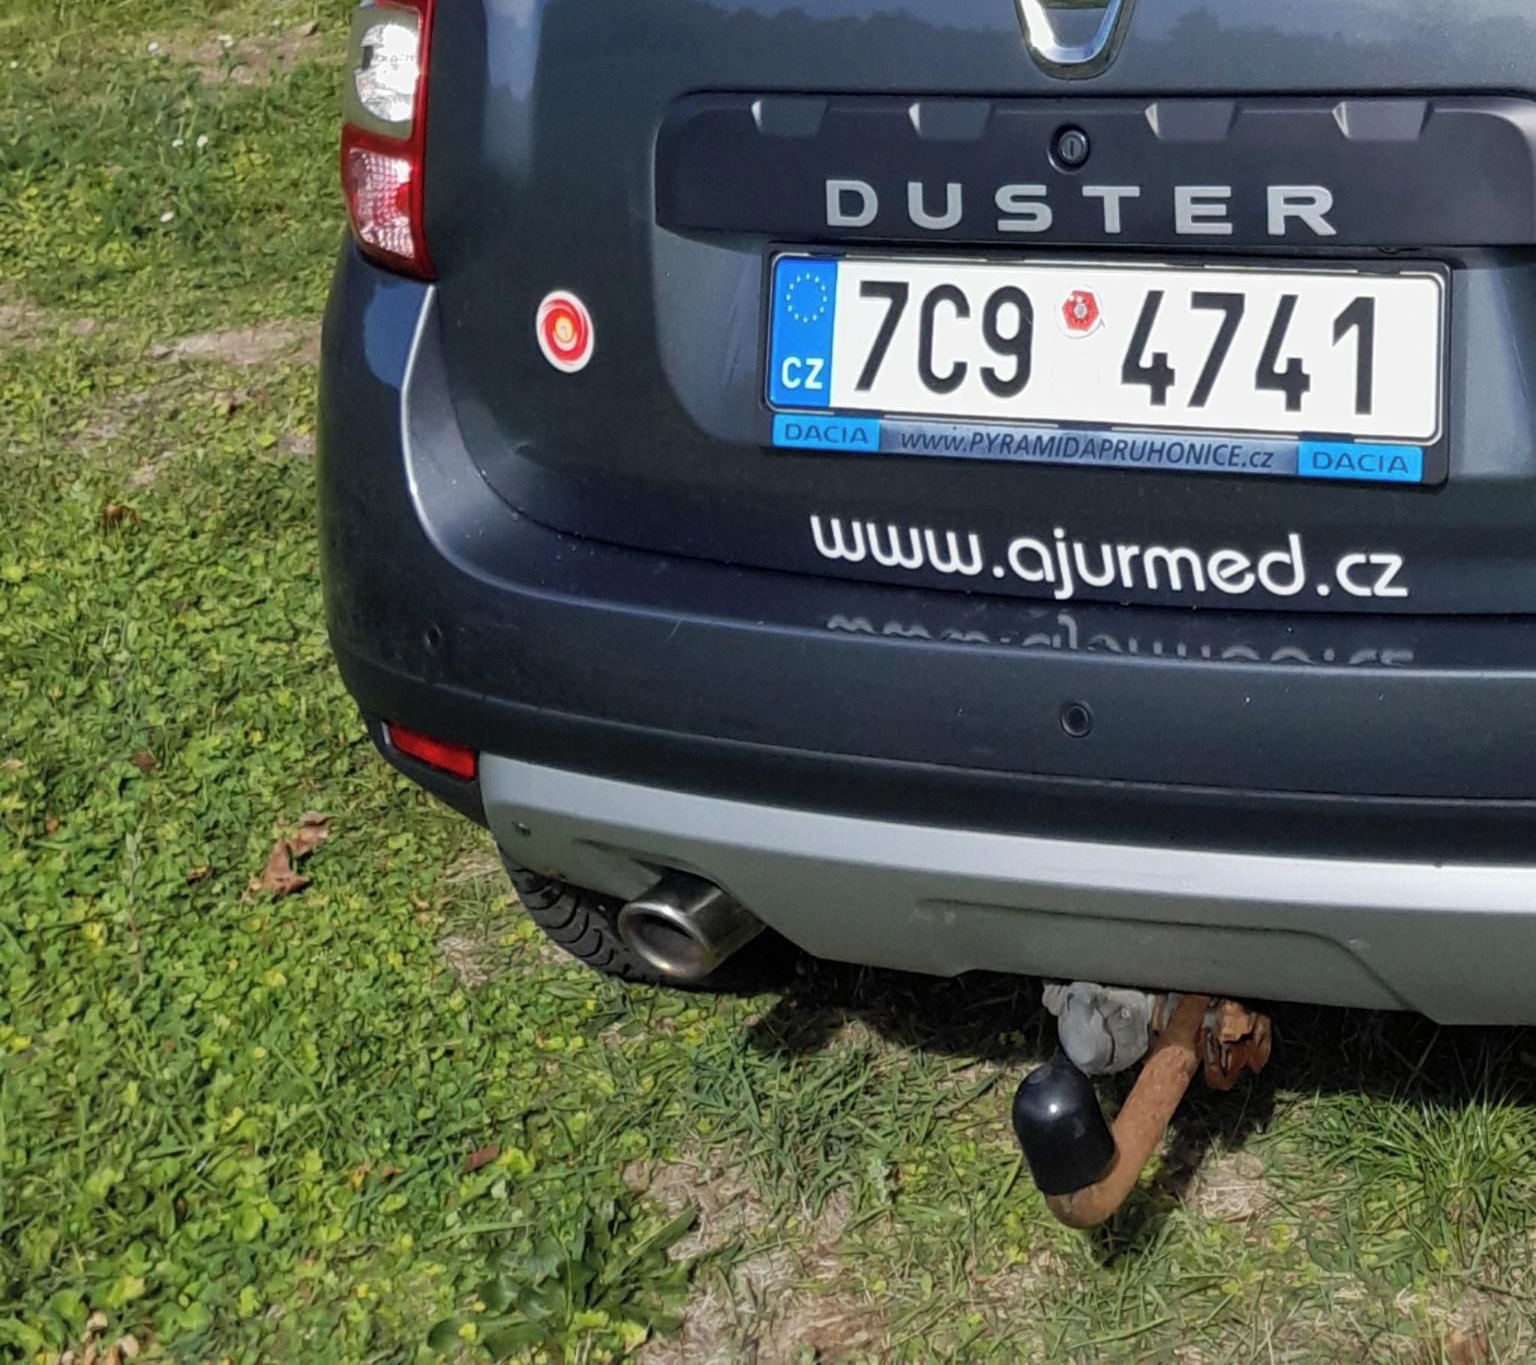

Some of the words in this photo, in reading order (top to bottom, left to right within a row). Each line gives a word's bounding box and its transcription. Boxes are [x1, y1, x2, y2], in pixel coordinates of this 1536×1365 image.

[825, 179, 1336, 237] DUSTER
[854, 280, 1034, 398] 7C9
[1121, 290, 1375, 415] 4741
[781, 356, 824, 390] CZ
[784, 423, 868, 444] DACIA
[1312, 452, 1409, 474] DACIA
[810, 515, 1409, 600] www.ajurmed.cz
